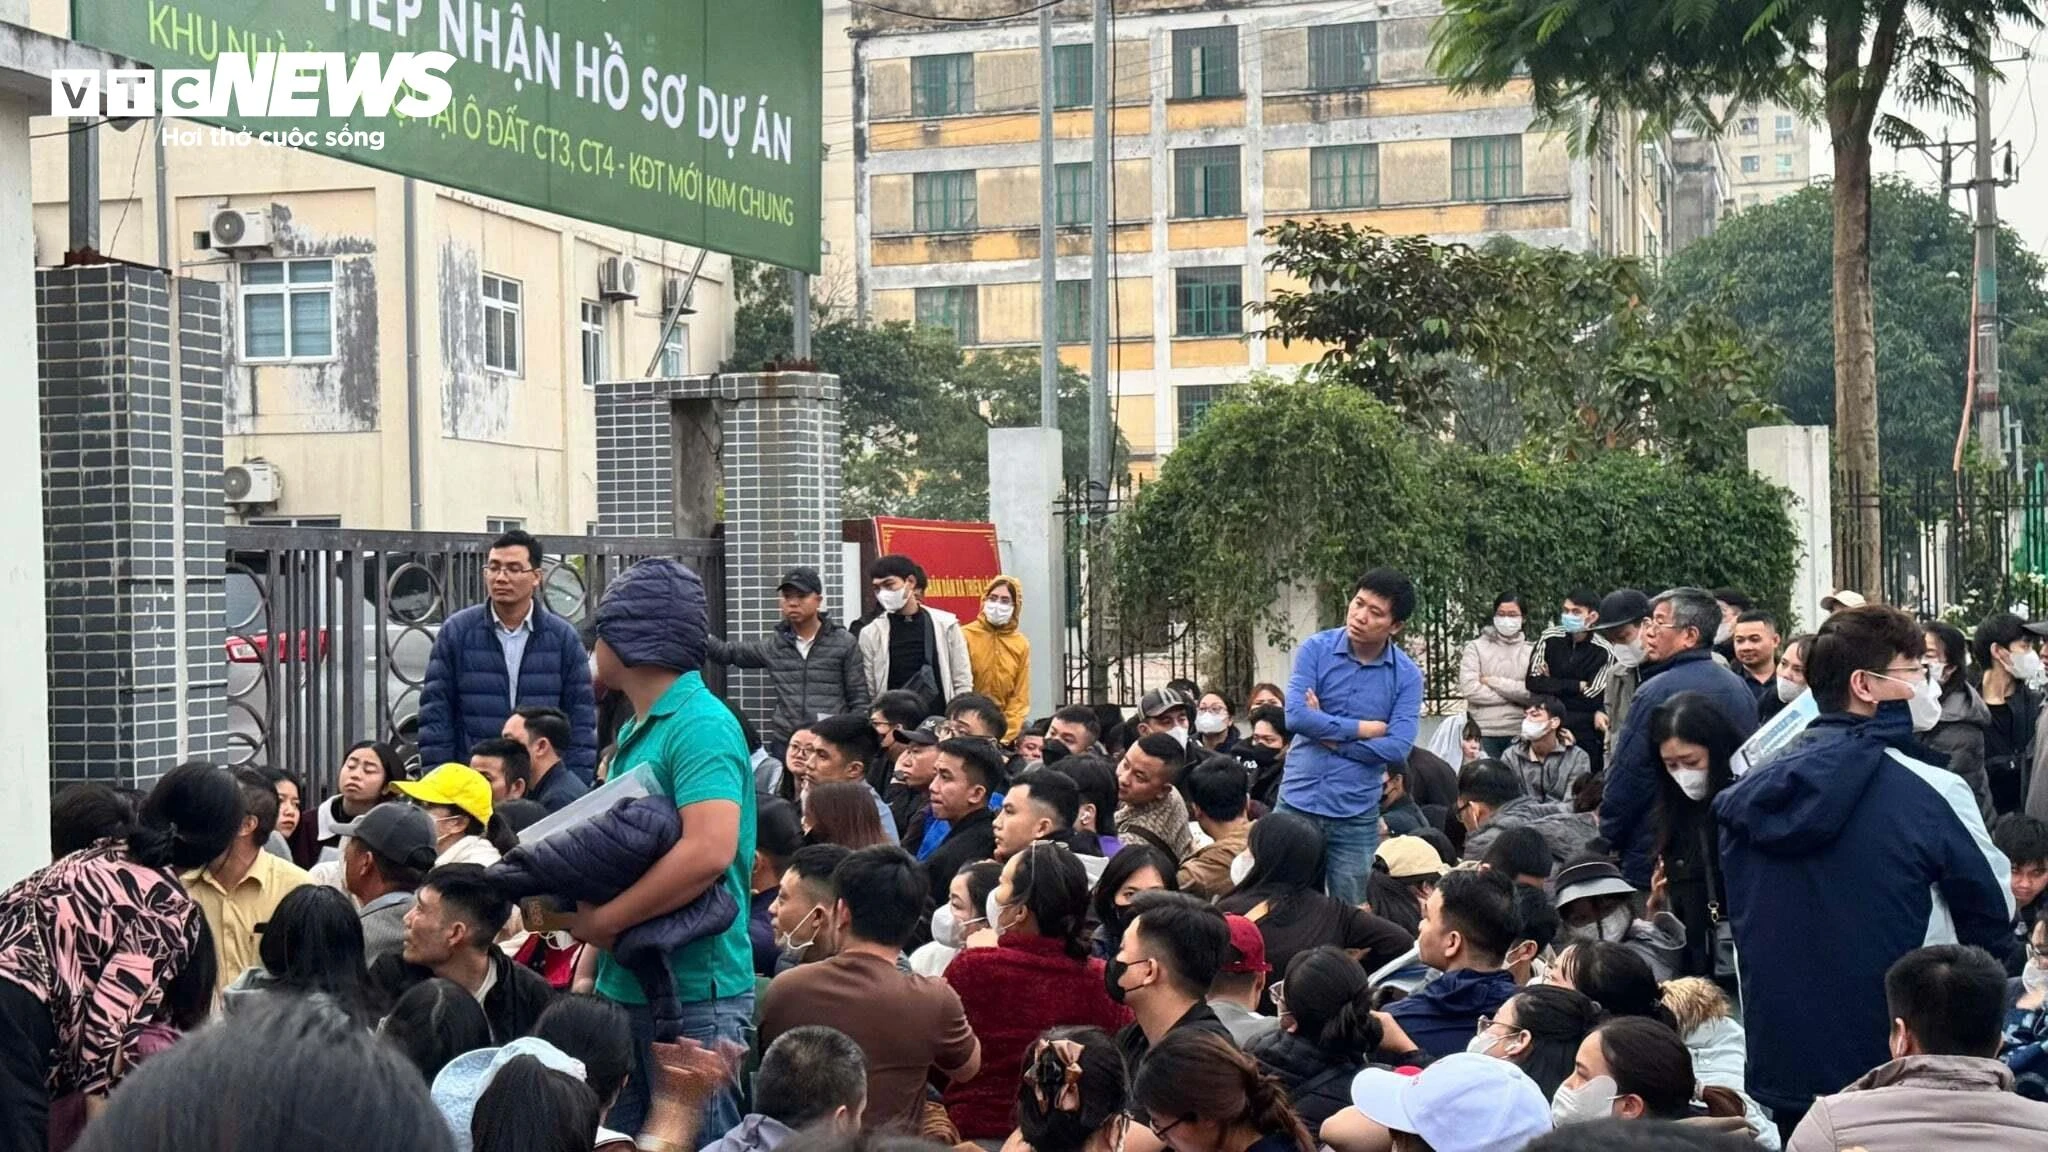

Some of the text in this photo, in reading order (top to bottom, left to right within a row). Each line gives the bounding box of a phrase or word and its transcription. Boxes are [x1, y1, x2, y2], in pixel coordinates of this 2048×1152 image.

[147, 1, 218, 62] KHU
[438, 0, 561, 93] NHẬN
[575, 31, 631, 111] HỒ
[640, 65, 688, 129] SƠ
[698, 84, 747, 160] DỰ
[751, 94, 792, 165] ÁN
[462, 93, 482, 140] Ô
[486, 104, 530, 154] ĐẤT
[532, 124, 575, 174] CT3,
[578, 138, 615, 179] CT4
[629, 152, 665, 193] KĐT
[668, 161, 703, 204] MỚI
[705, 174, 737, 213] KIM
[738, 184, 795, 227] CHUNG
